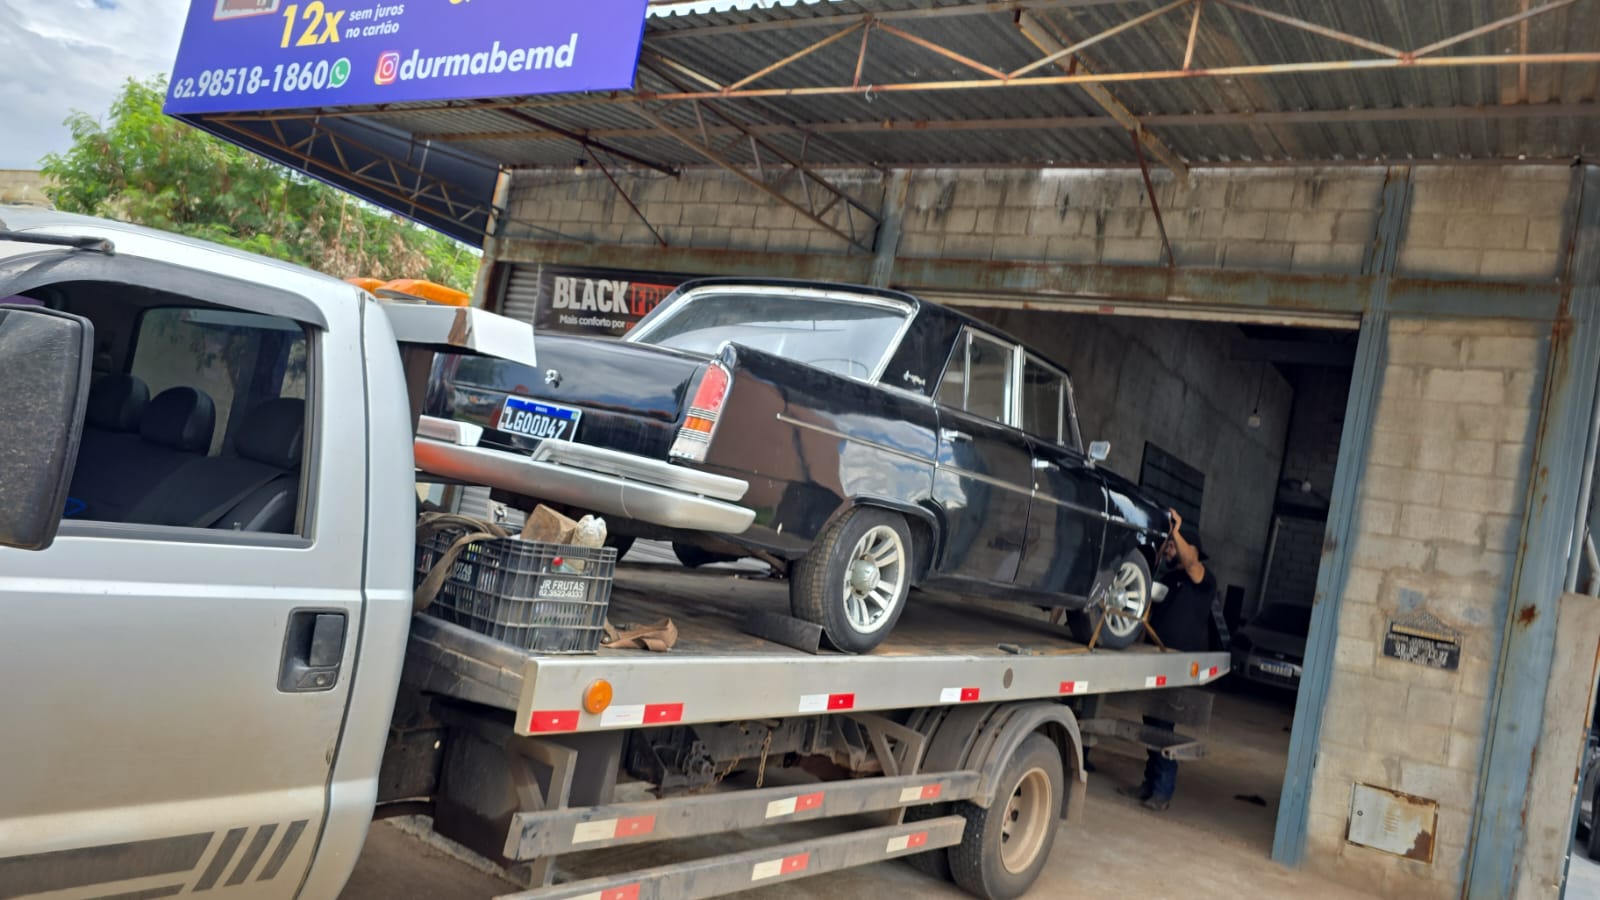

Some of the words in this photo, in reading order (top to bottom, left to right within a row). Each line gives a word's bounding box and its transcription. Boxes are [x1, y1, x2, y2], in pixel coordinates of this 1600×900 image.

[349, 9, 373, 22] sem
[374, 4, 405, 23] juros
[280, 1, 345, 48] 12x
[345, 26, 360, 39] no
[363, 21, 399, 37] cartão
[400, 33, 578, 80] durmabemd
[552, 276, 629, 314] BLACK
[559, 314, 578, 325] Mais
[579, 316, 611, 328] conforto
[612, 320, 625, 329] por
[540, 579, 552, 590] JR
[552, 580, 585, 591] FRUTAS
